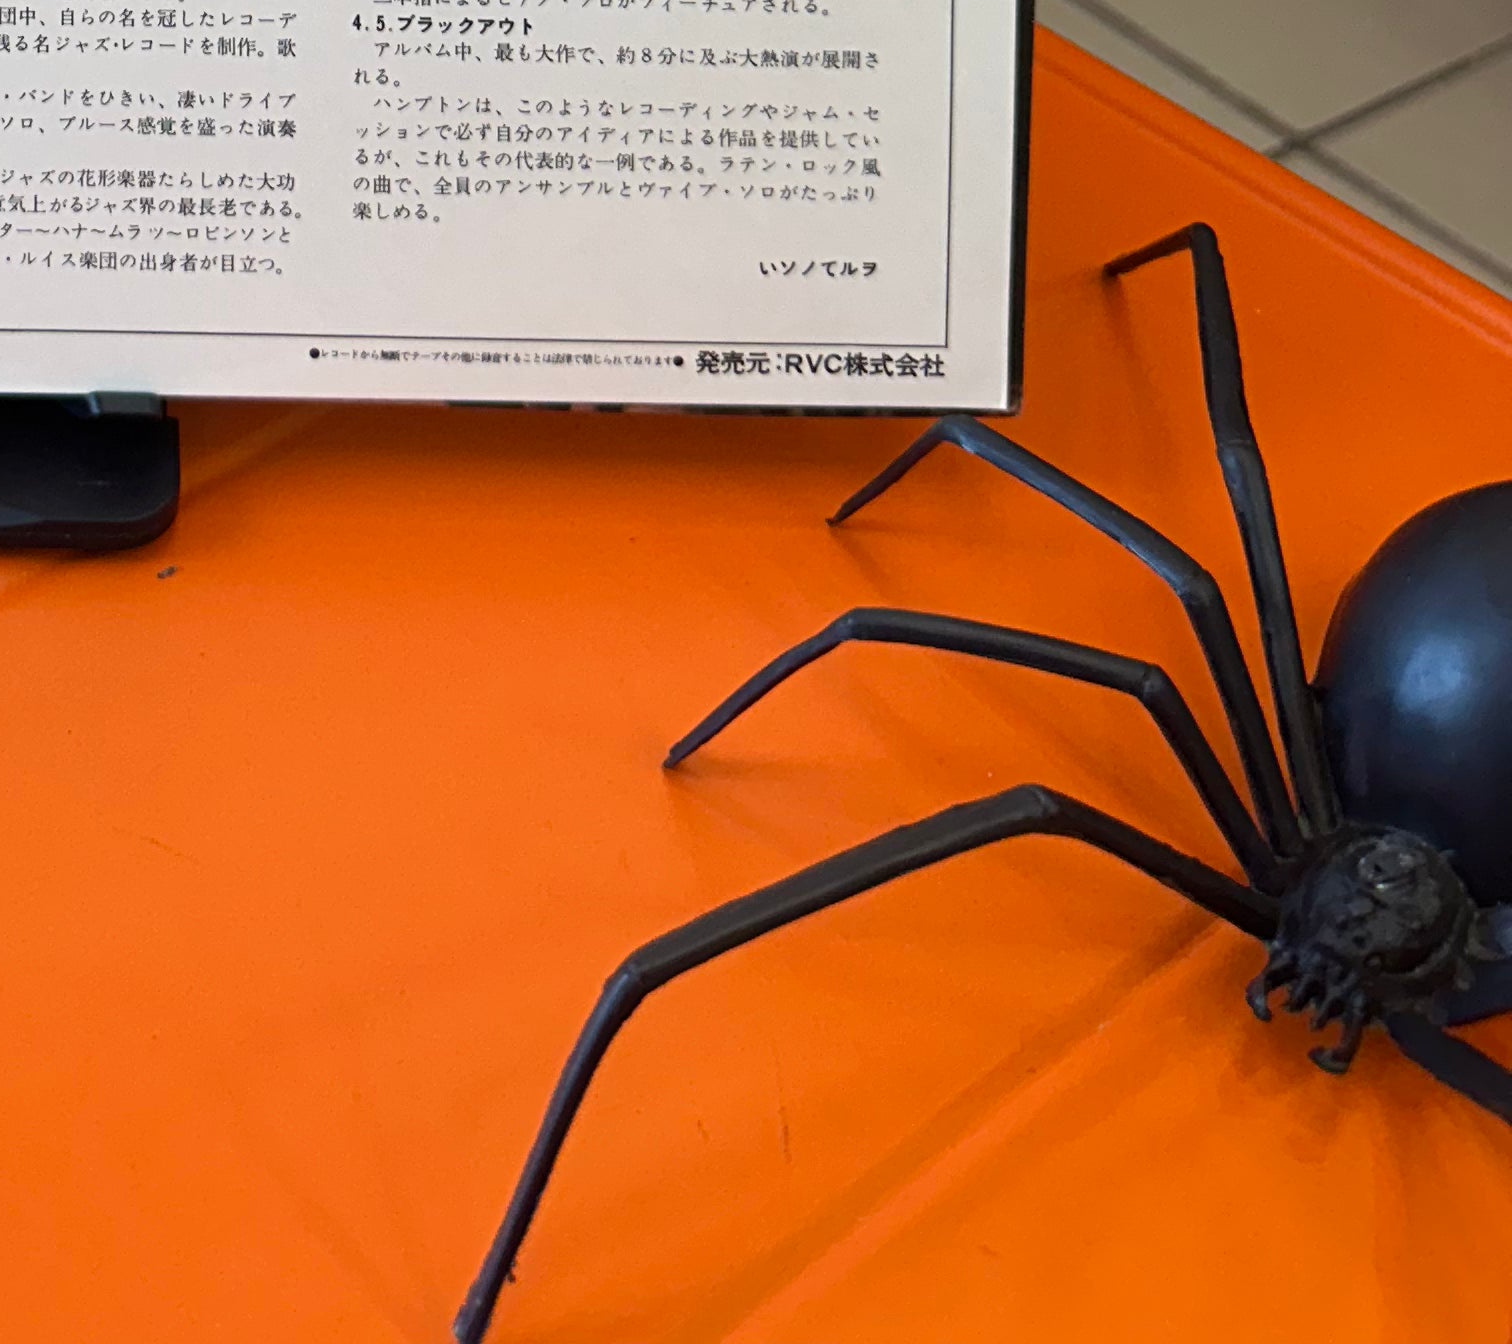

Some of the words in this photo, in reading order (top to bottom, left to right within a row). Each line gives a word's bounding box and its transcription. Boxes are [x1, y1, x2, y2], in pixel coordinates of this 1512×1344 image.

[354, 68, 400, 88] れる。
[353, 201, 440, 223] 楽しめる。
